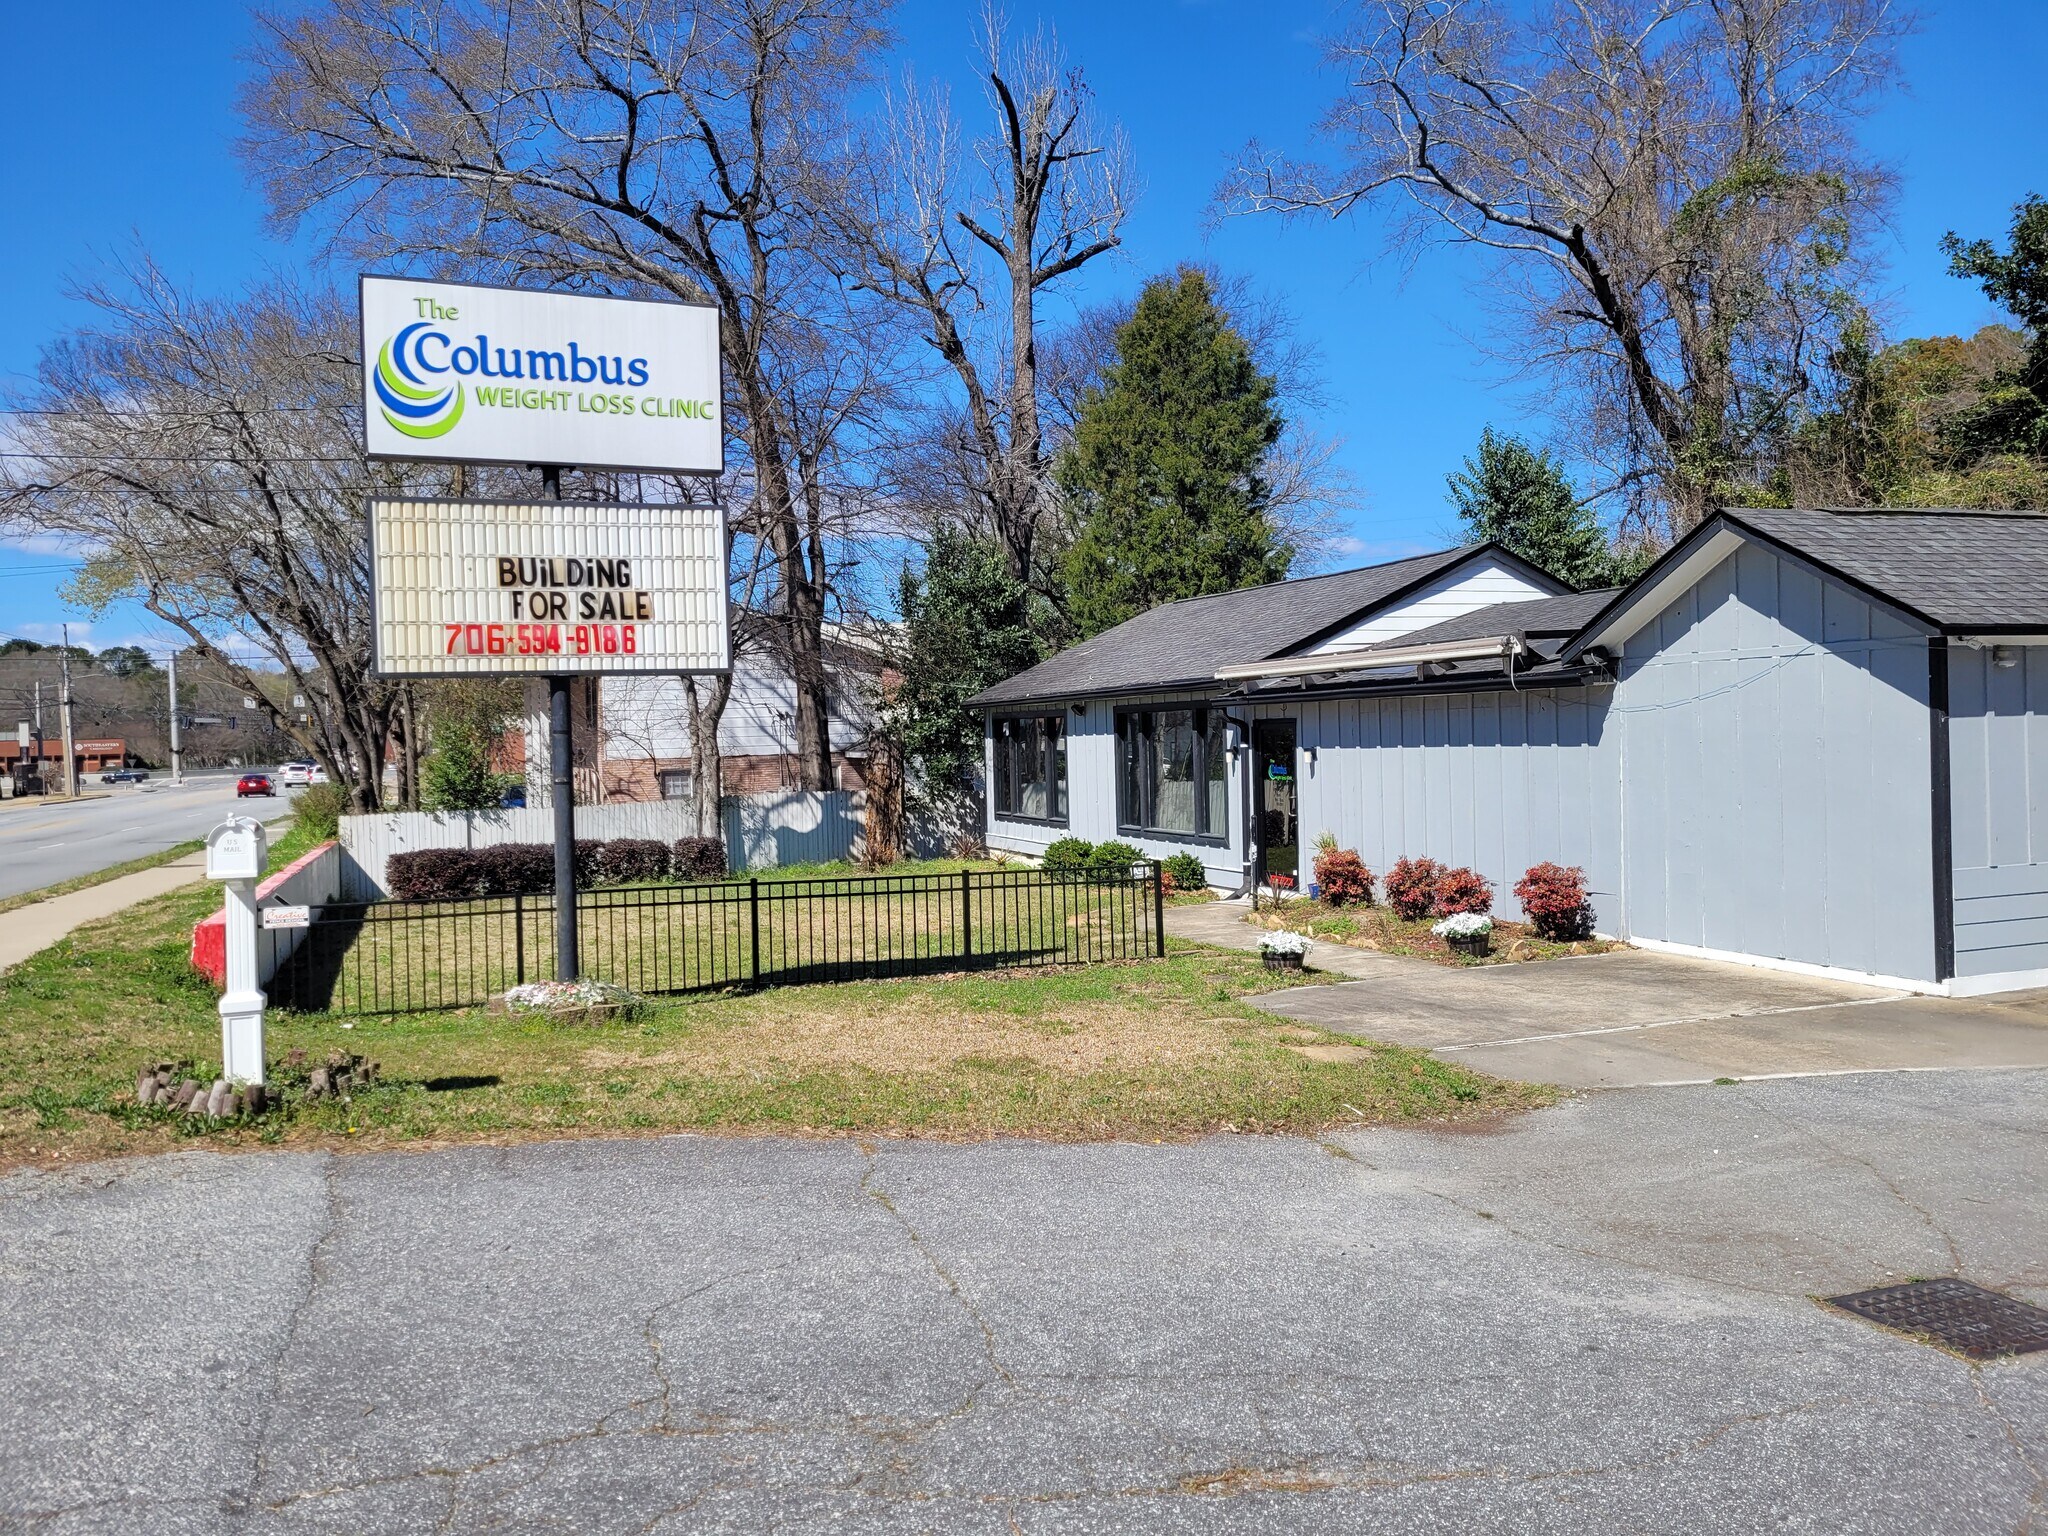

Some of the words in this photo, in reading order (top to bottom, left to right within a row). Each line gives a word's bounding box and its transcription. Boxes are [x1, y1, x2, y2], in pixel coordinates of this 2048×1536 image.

[413, 297, 459, 320] The
[414, 331, 650, 387] Columbus
[475, 386, 572, 411] WEIGHT
[578, 393, 636, 415] LOSS
[642, 397, 715, 420] CLINIC
[513, 591, 568, 620] FOR
[579, 591, 651, 620] SALE
